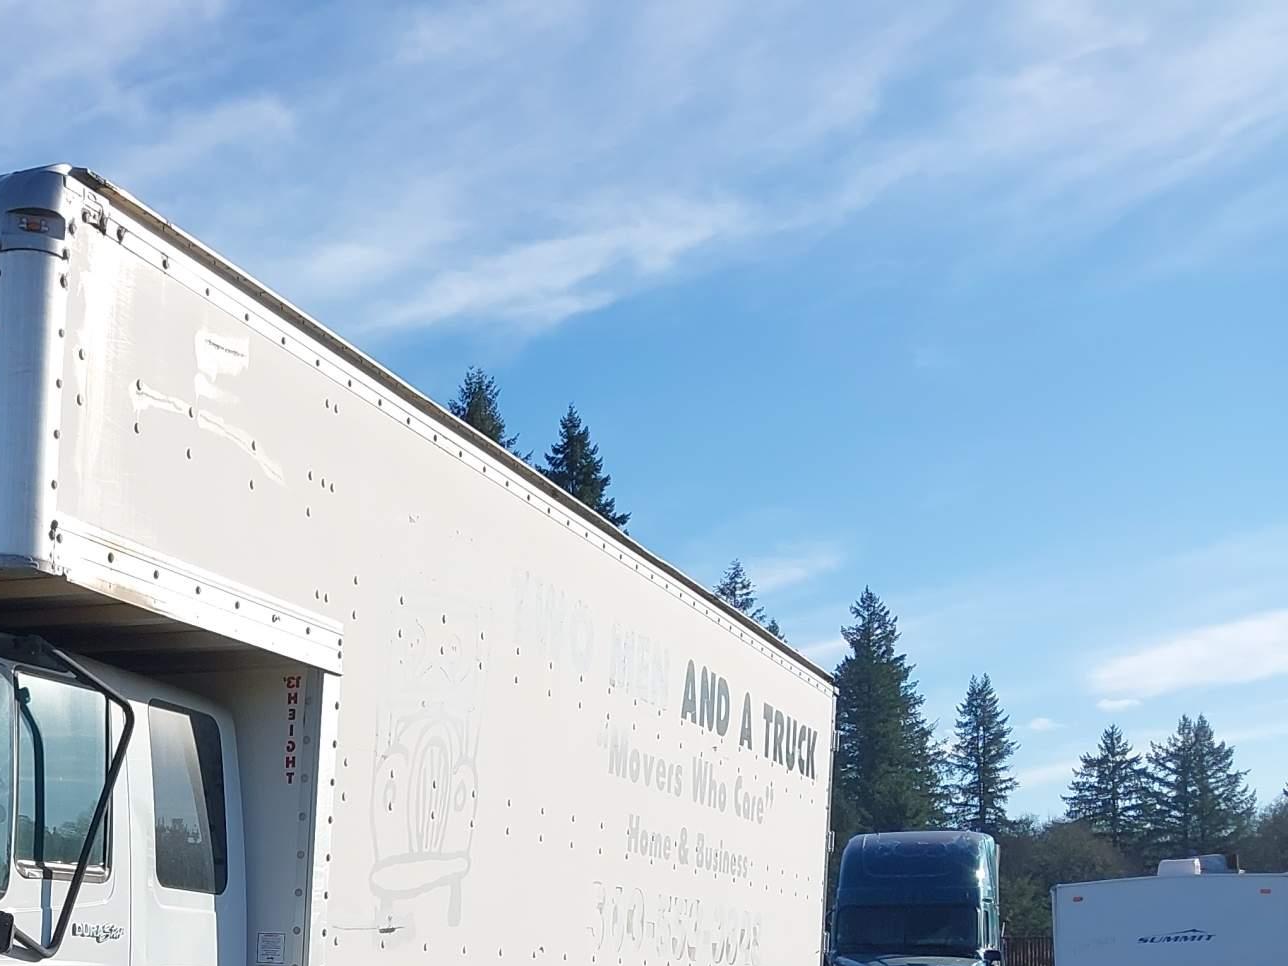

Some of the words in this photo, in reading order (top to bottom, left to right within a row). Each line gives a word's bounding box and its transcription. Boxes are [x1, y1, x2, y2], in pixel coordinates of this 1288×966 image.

[681, 658, 730, 737] AND
[739, 691, 753, 751] A
[763, 702, 818, 780] TRUCK
[692, 756, 727, 813] Who
[627, 813, 672, 860] Home
[678, 827, 689, 865] &
[696, 832, 748, 879] Business
[1137, 934, 1216, 944] SUMMIT
